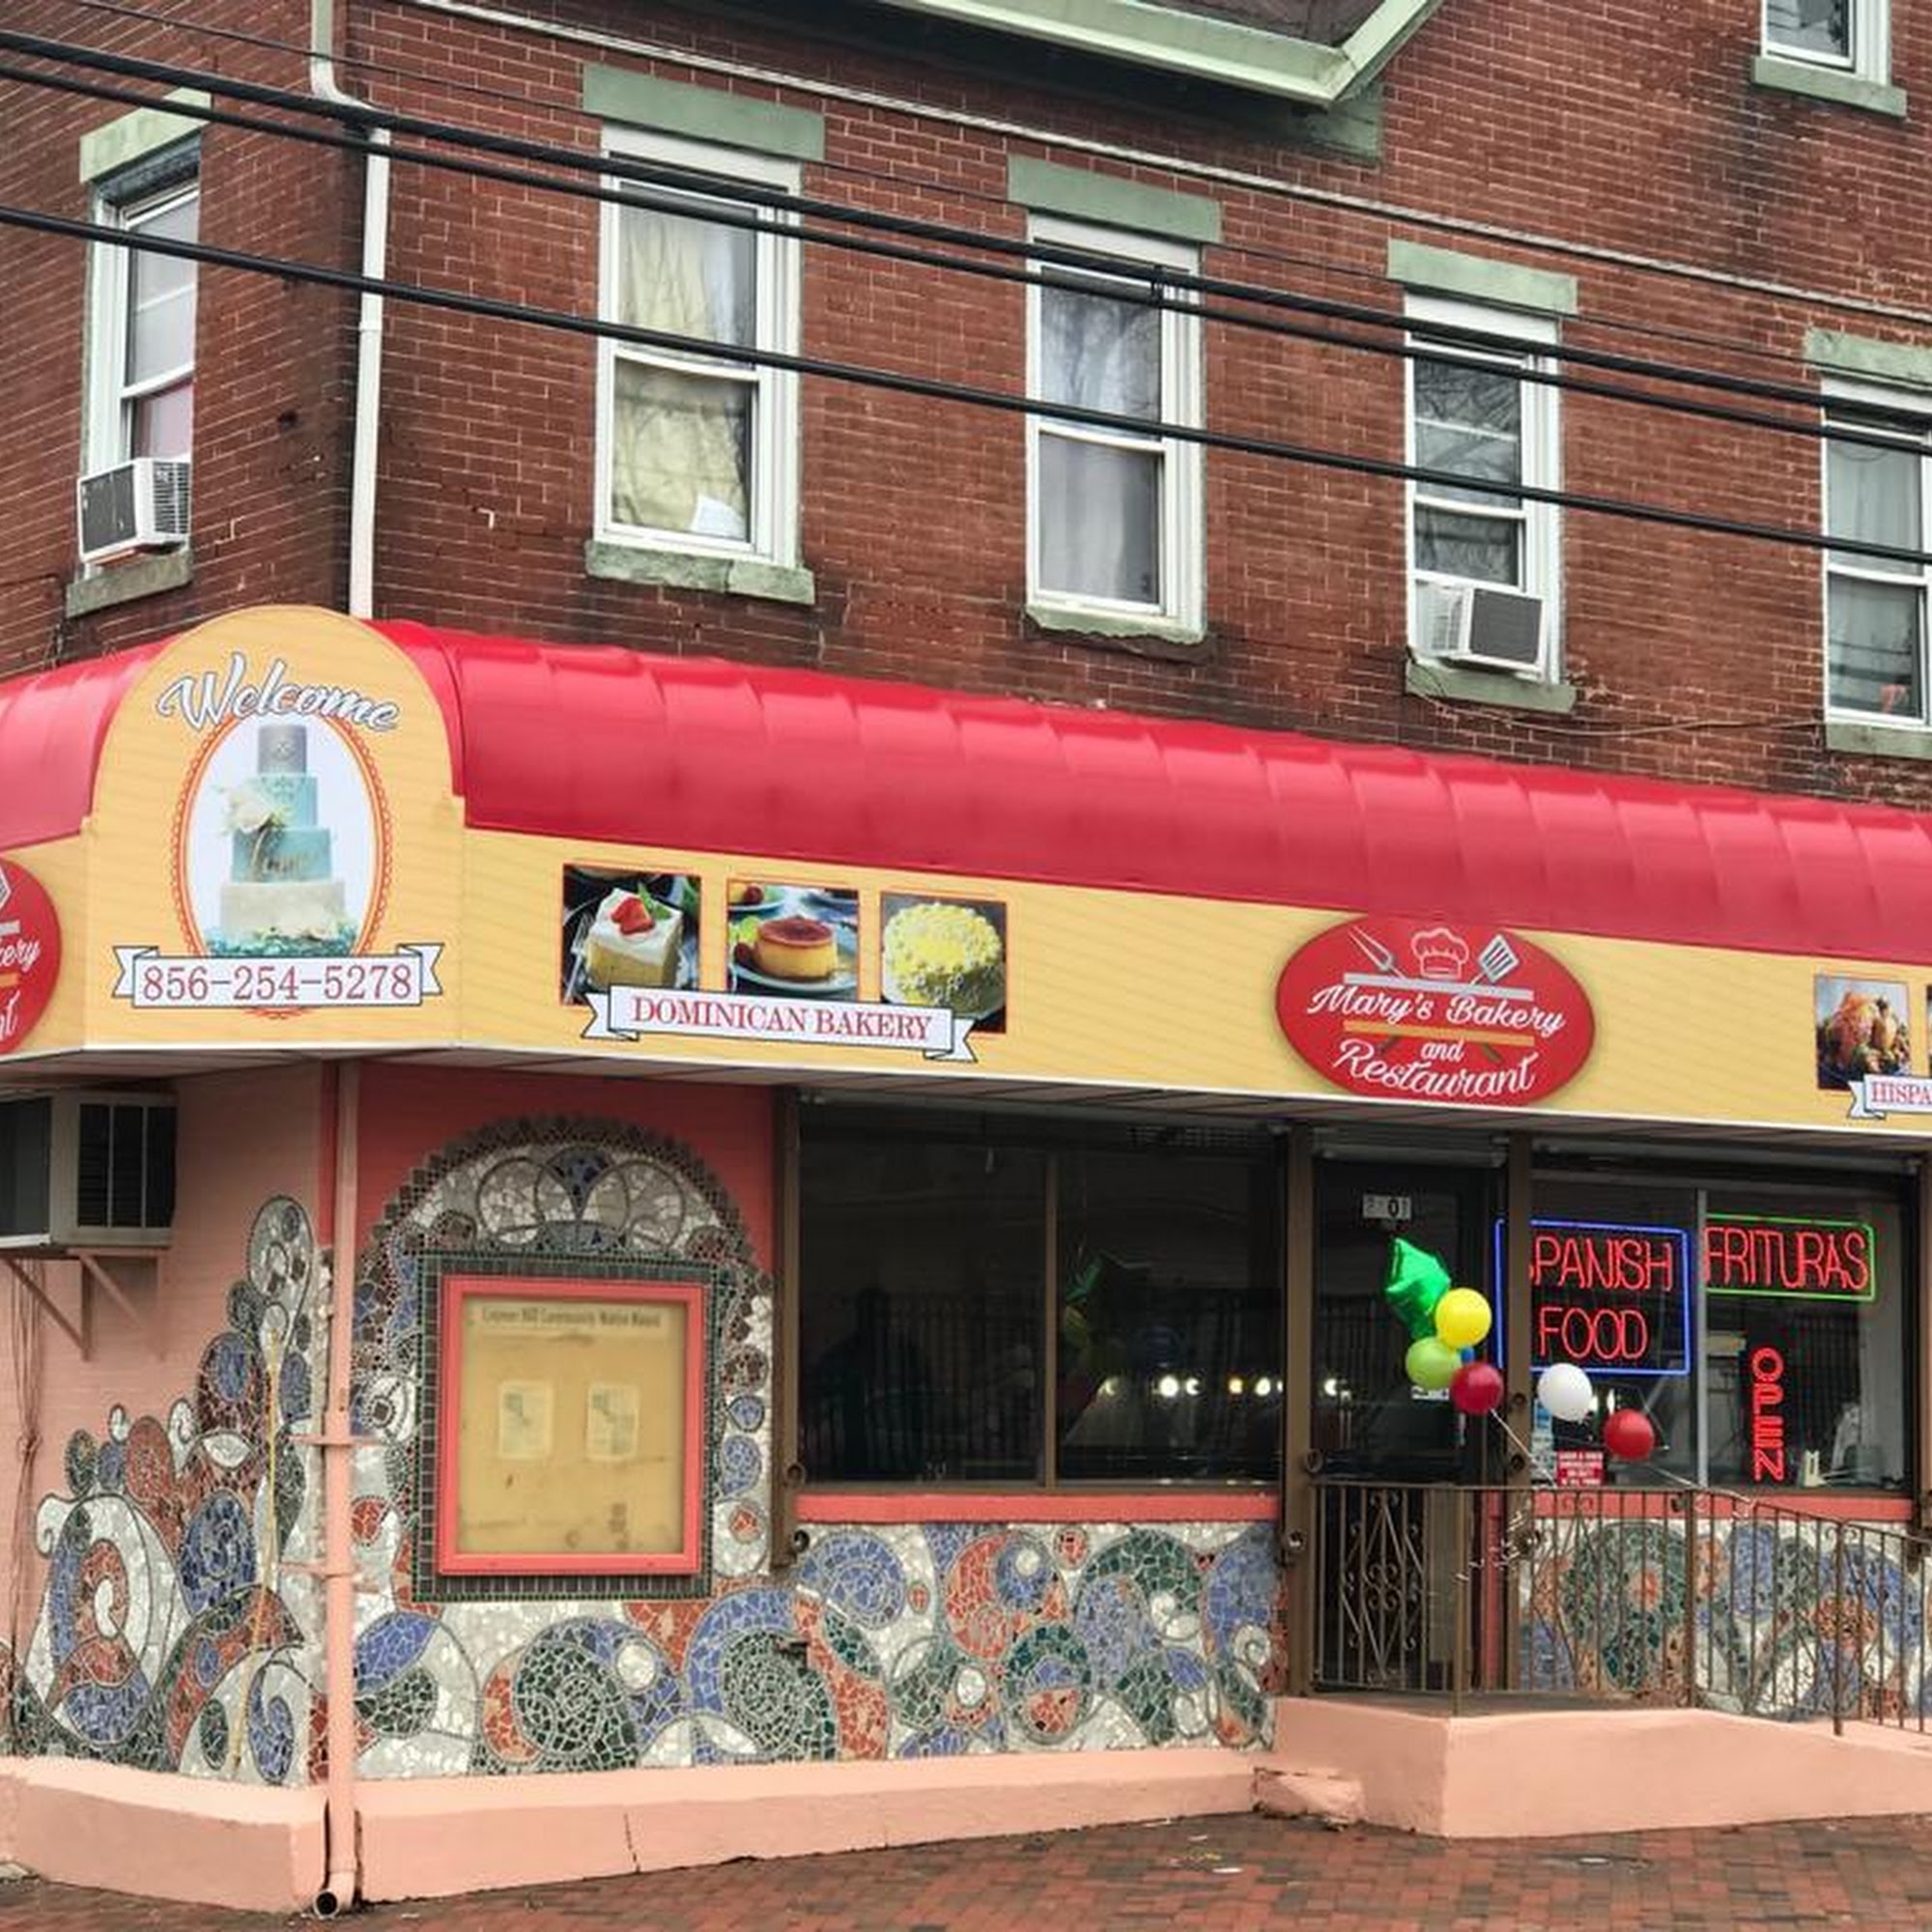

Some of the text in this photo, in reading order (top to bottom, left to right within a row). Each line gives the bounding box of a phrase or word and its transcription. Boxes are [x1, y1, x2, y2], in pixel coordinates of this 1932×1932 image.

[156, 651, 402, 732] Welcome
[142, 964, 413, 1001] 856-254-5278
[633, 996, 932, 1041] DOMINICAN BAKERY
[1307, 985, 1566, 1037] Mary's Bakery
[1333, 1038, 1539, 1098] Restaurant
[1421, 1040, 1464, 1064] and
[1529, 1235, 1673, 1292] PANISH
[1704, 1226, 1868, 1291] FRITURAS
[1539, 1306, 1648, 1360] FOOD
[1751, 1347, 1784, 1482] OPEN
